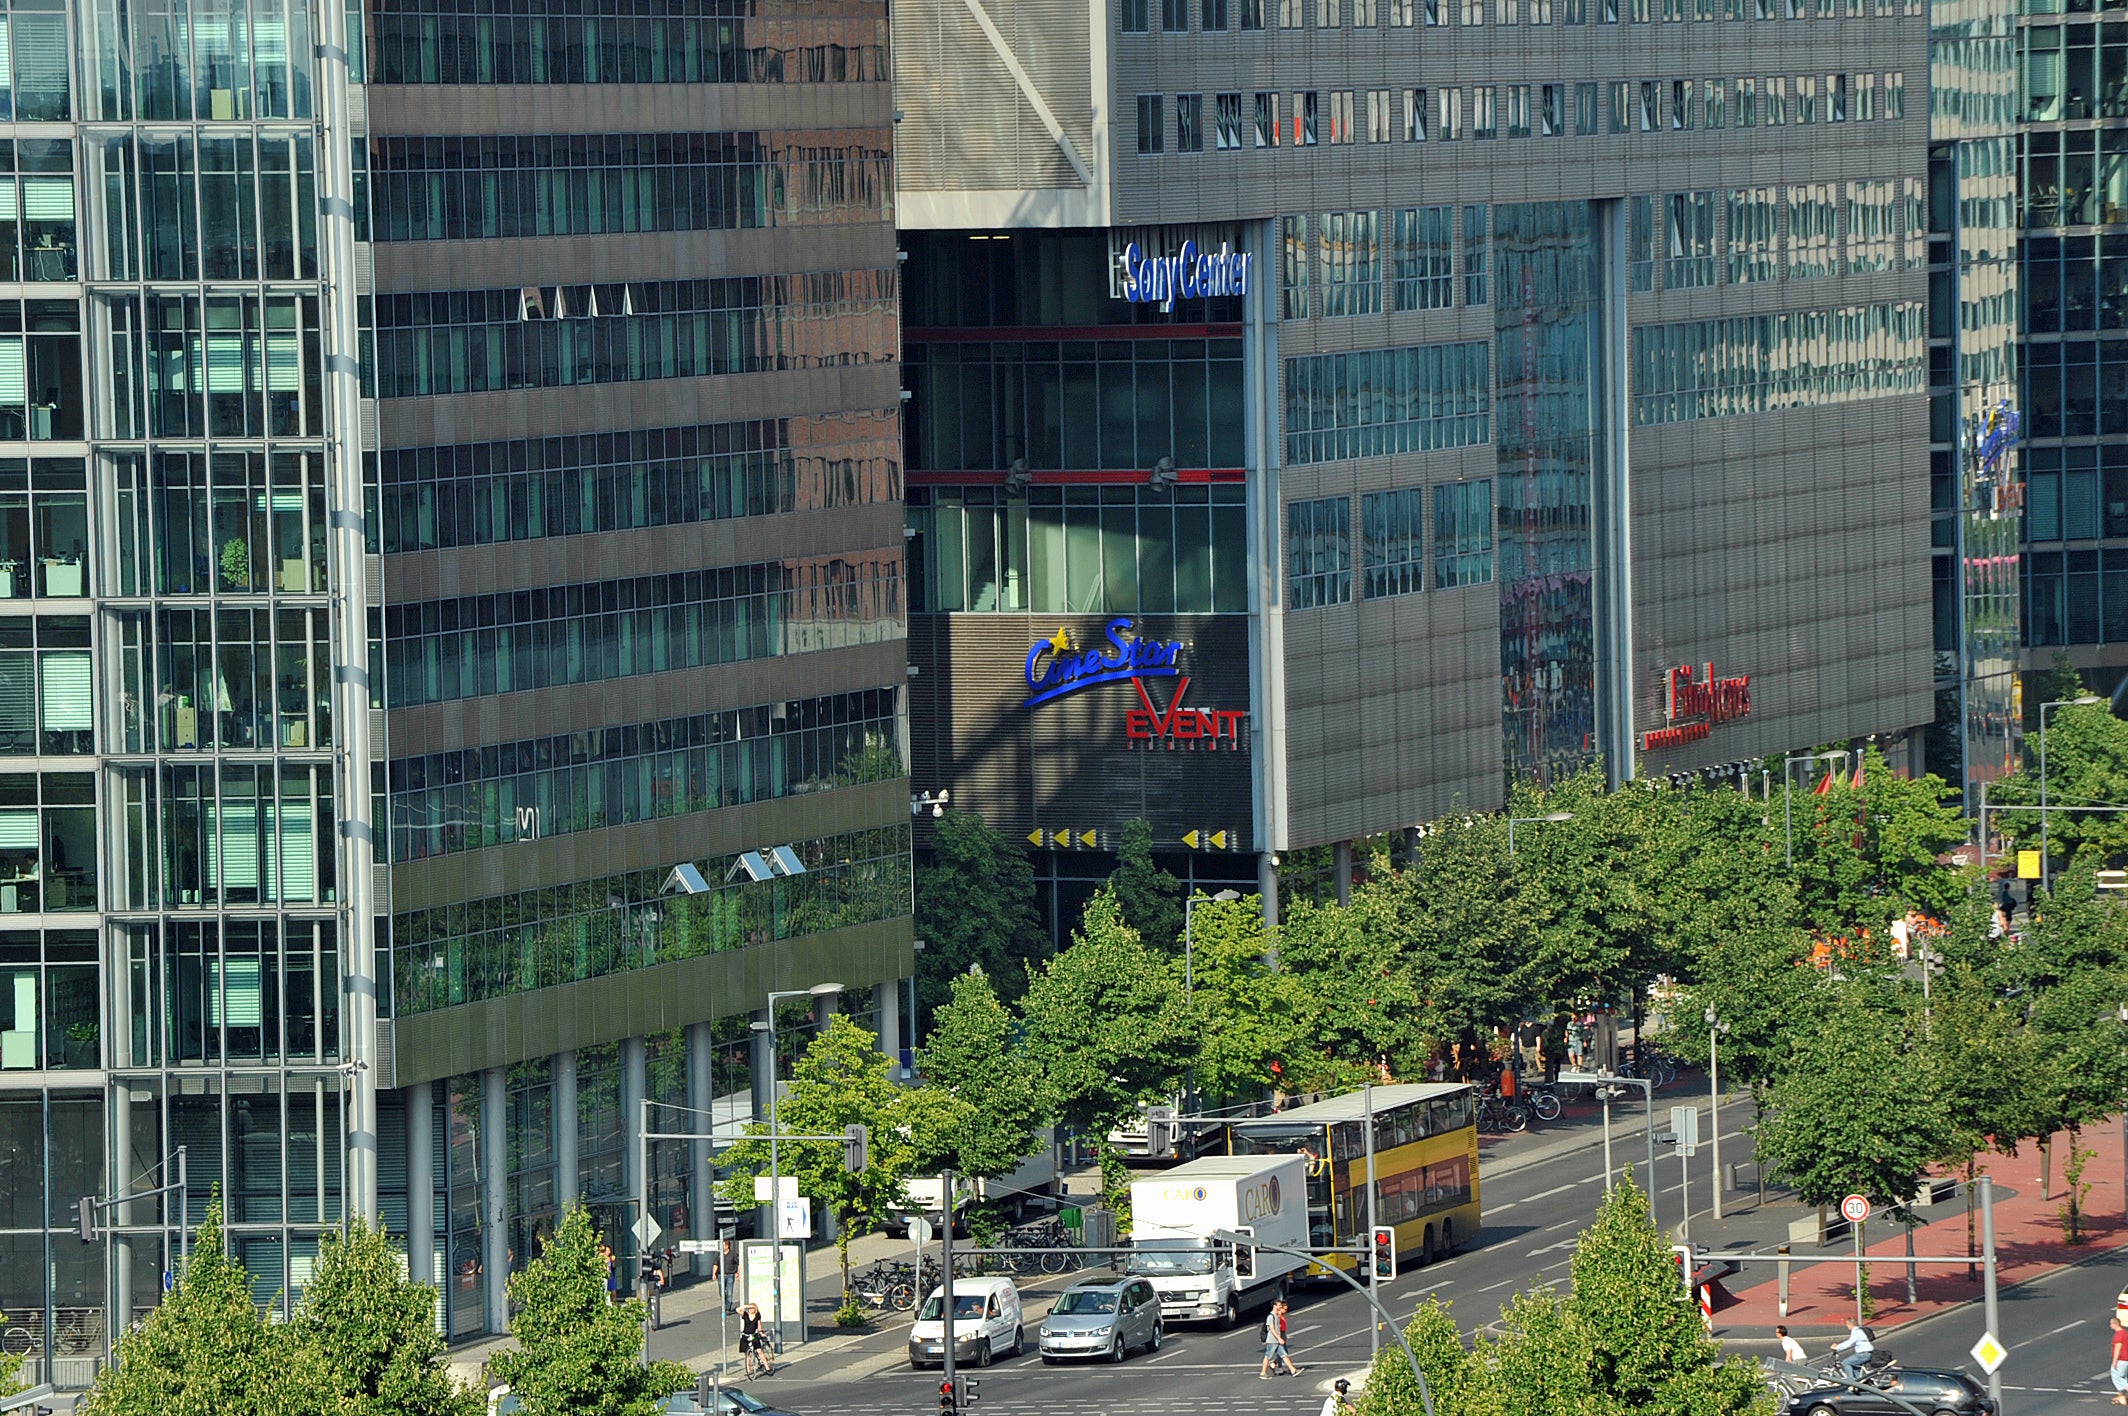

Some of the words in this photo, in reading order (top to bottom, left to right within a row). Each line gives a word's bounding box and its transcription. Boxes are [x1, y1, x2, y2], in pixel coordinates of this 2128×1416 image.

[1124, 242, 1178, 313] Sony
[1179, 239, 1252, 299] Center
[1126, 676, 1245, 739] EVENT
[1163, 1187, 1207, 1202] CARO
[1245, 1174, 1281, 1221] CARO
[1848, 1202, 1863, 1214] 30
